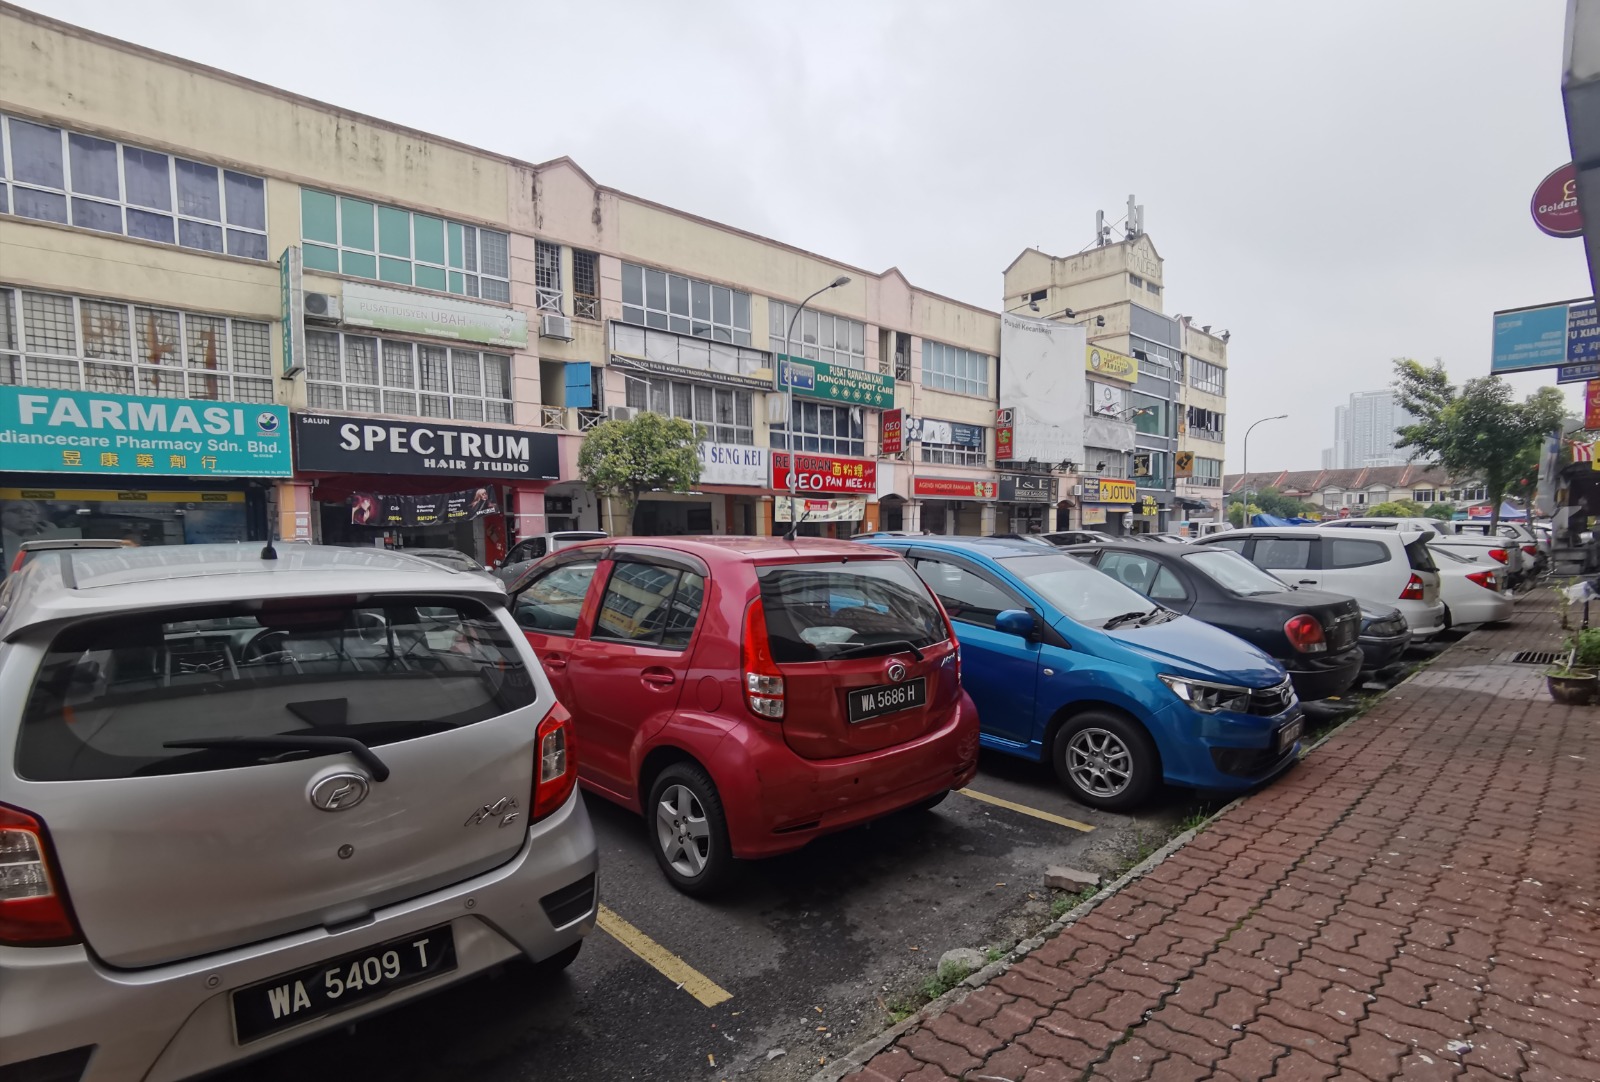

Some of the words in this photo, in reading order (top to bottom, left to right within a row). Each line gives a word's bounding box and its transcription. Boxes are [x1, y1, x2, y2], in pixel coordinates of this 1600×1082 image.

[1539, 200, 1577, 213] Golden
[281, 257, 289, 368] FARMASI
[360, 302, 389, 315] PUSAT
[391, 307, 427, 320] TUISYEN
[431, 312, 466, 326] UBAH
[1004, 318, 1020, 329] Pusat
[817, 374, 856, 388] DONGXING
[858, 381, 876, 392] FOOT
[877, 385, 894, 395] CARE
[829, 366, 847, 376] PUSAT
[848, 369, 871, 382] RAWATAN
[871, 374, 884, 385] KAKI
[18, 394, 245, 436] FARMASI
[302, 416, 330, 425] SALUN
[885, 421, 900, 431] CEO
[0, 430, 110, 448] diancecare
[116, 435, 202, 453] Pharmacy
[207, 439, 243, 452] Sdn.
[247, 440, 282, 454] Bhd.
[340, 424, 530, 460] SPECTRUM
[62, 450, 218, 470] 昱康藥劑行
[424, 458, 467, 470] HAIR
[473, 460, 530, 473] STUDIO
[711, 446, 740, 465] SENG
[744, 450, 761, 466] KEI
[785, 472, 823, 490] CEO
[825, 475, 842, 487] PAN
[845, 478, 863, 488] MEE
[1022, 481, 1035, 489] &
[1039, 479, 1048, 489] E
[1110, 485, 1135, 500] JOTUN
[861, 694, 876, 712] WA
[877, 687, 905, 708] 5686
[907, 685, 915, 700] H
[268, 984, 311, 1020] WA
[324, 950, 402, 999] 5409
[413, 939, 431, 969] T
